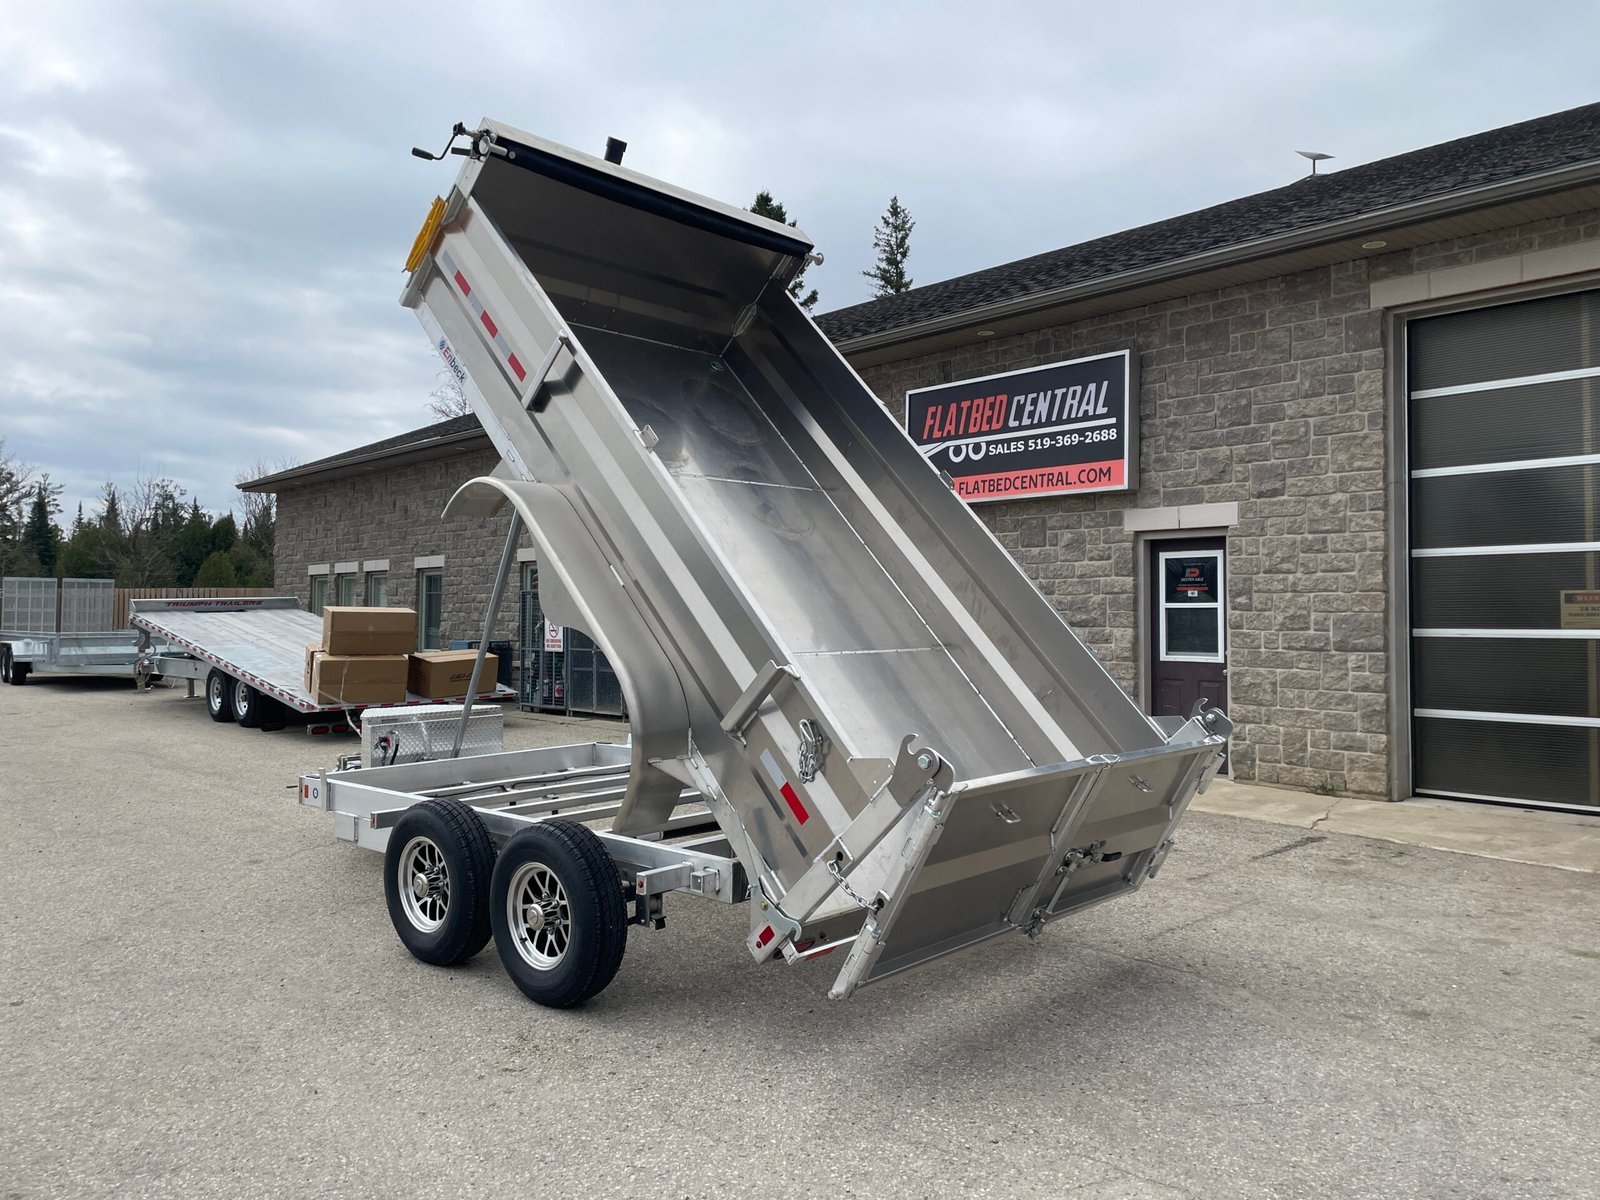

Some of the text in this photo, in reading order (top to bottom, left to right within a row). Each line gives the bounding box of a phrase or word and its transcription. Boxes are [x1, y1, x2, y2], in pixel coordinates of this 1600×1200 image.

[442, 346, 466, 383] Enbeck
[922, 380, 1109, 440] FLATBED CENTRAL
[988, 428, 1118, 456] SALES 519-369-2688
[958, 466, 1112, 496] FLATBEDCENTRAL.COM
